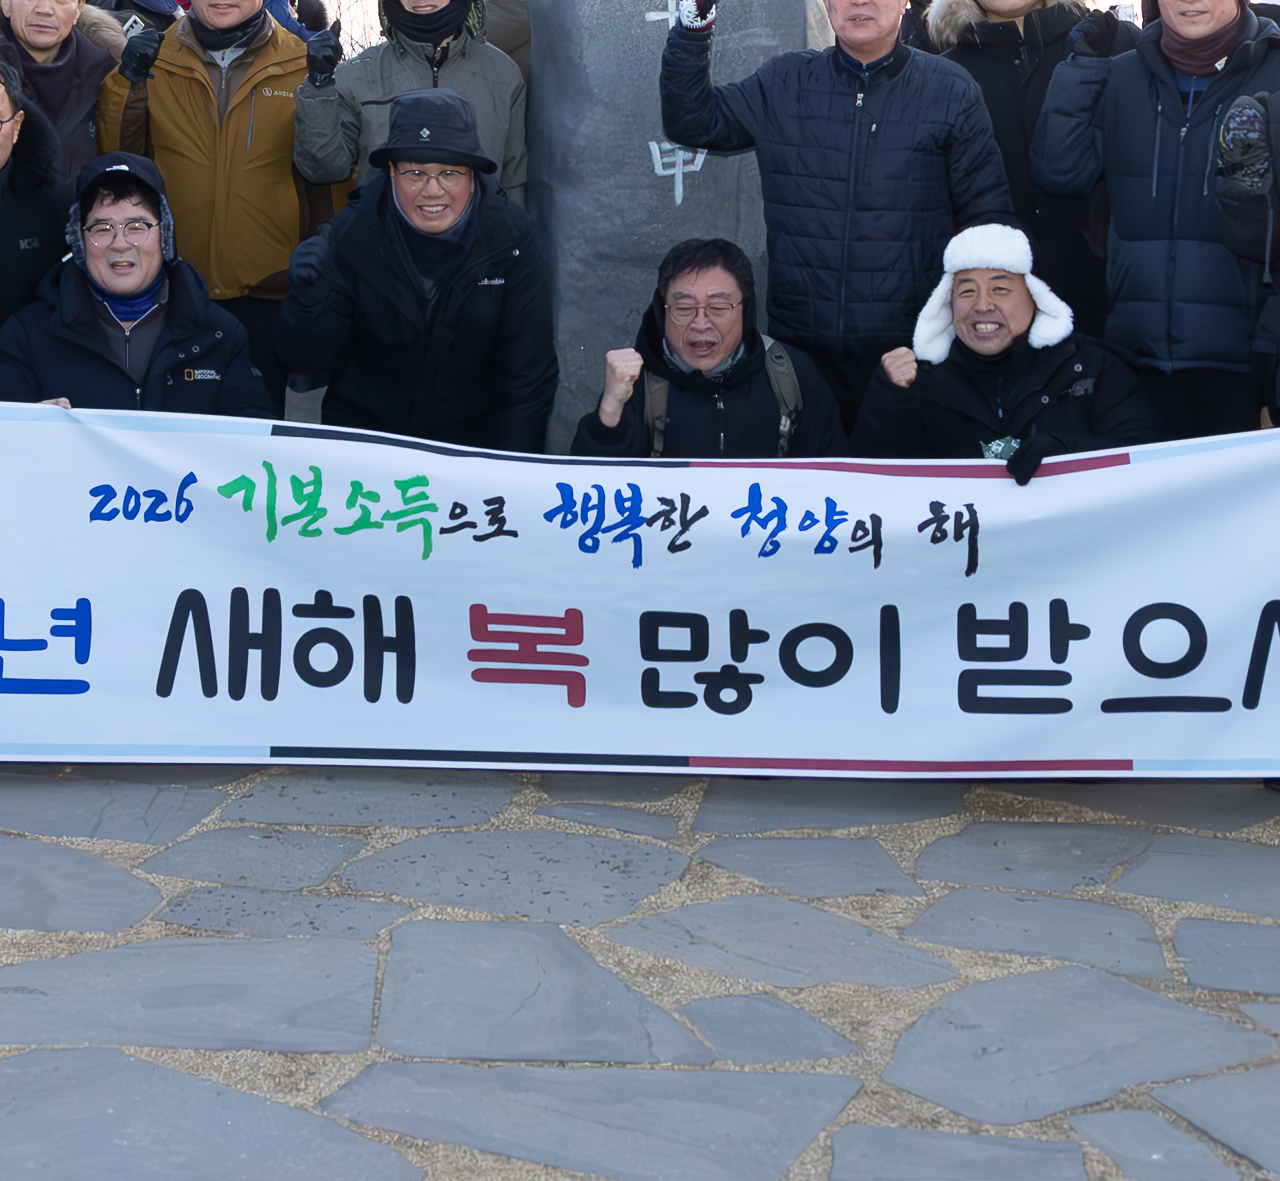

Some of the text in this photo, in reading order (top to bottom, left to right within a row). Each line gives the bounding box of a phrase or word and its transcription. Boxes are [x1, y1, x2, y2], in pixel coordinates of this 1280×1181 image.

[273, 90, 294, 98] AIGLE
[88, 459, 980, 578] 2026 기본소득으로 행복한 청양의 해
[155, 587, 417, 705] 새해
[466, 603, 591, 708] 복
[639, 603, 902, 716] 많이
